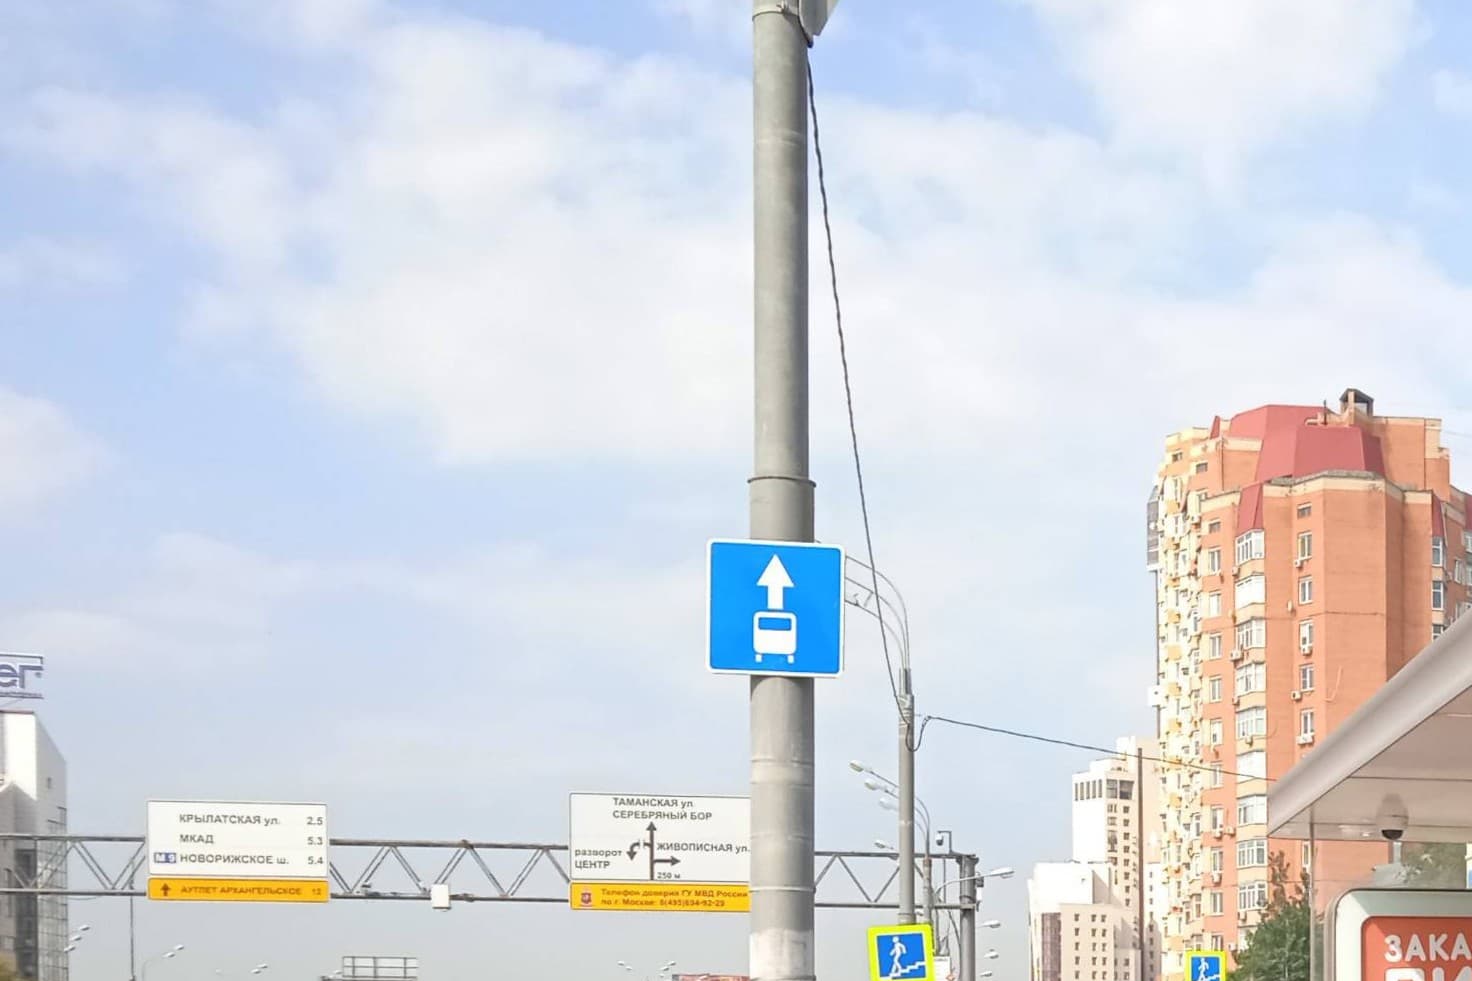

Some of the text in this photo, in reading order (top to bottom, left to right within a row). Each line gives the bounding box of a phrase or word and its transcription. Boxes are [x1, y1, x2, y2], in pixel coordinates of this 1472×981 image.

[612, 797, 678, 808] ТАМАНСКАЯ
[179, 814, 261, 825] КРЫЛАТСКАЯ
[612, 809, 713, 821] СЕРЕБРЯНЫЙ БОР
[179, 834, 214, 845] МКАД
[656, 842, 733, 853] ЖИВОПИСНАЯ
[180, 854, 273, 865] НОВОРИЖСКОЕ
[574, 849, 623, 859] разворот
[574, 860, 611, 870] ЦЕНТР
